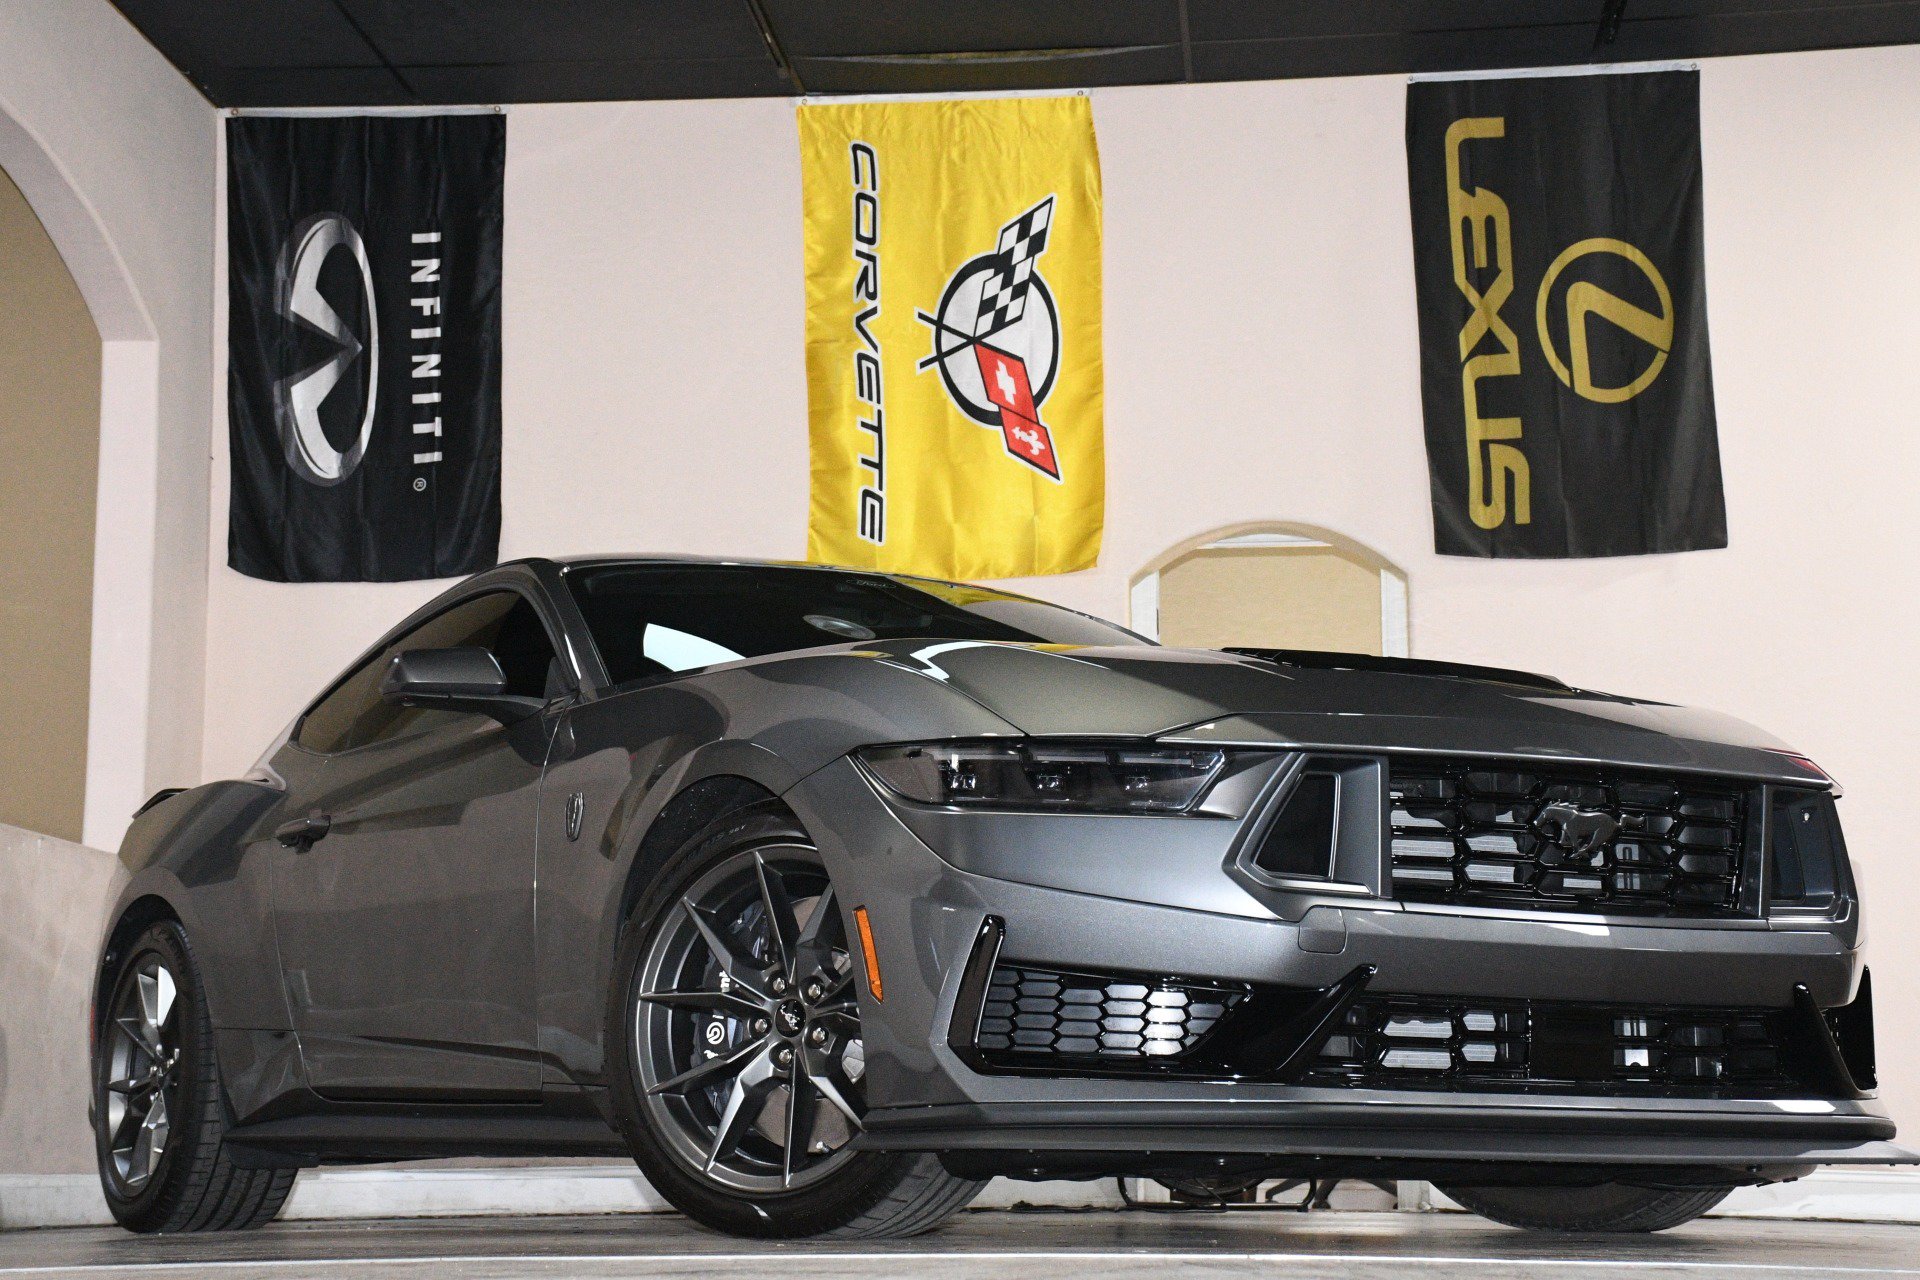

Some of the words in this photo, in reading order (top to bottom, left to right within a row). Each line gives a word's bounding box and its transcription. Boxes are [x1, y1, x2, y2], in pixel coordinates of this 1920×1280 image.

[411, 231, 442, 464] INFINITI
[849, 140, 886, 545] CORVETTE
[1444, 116, 1531, 530] LEXUS
